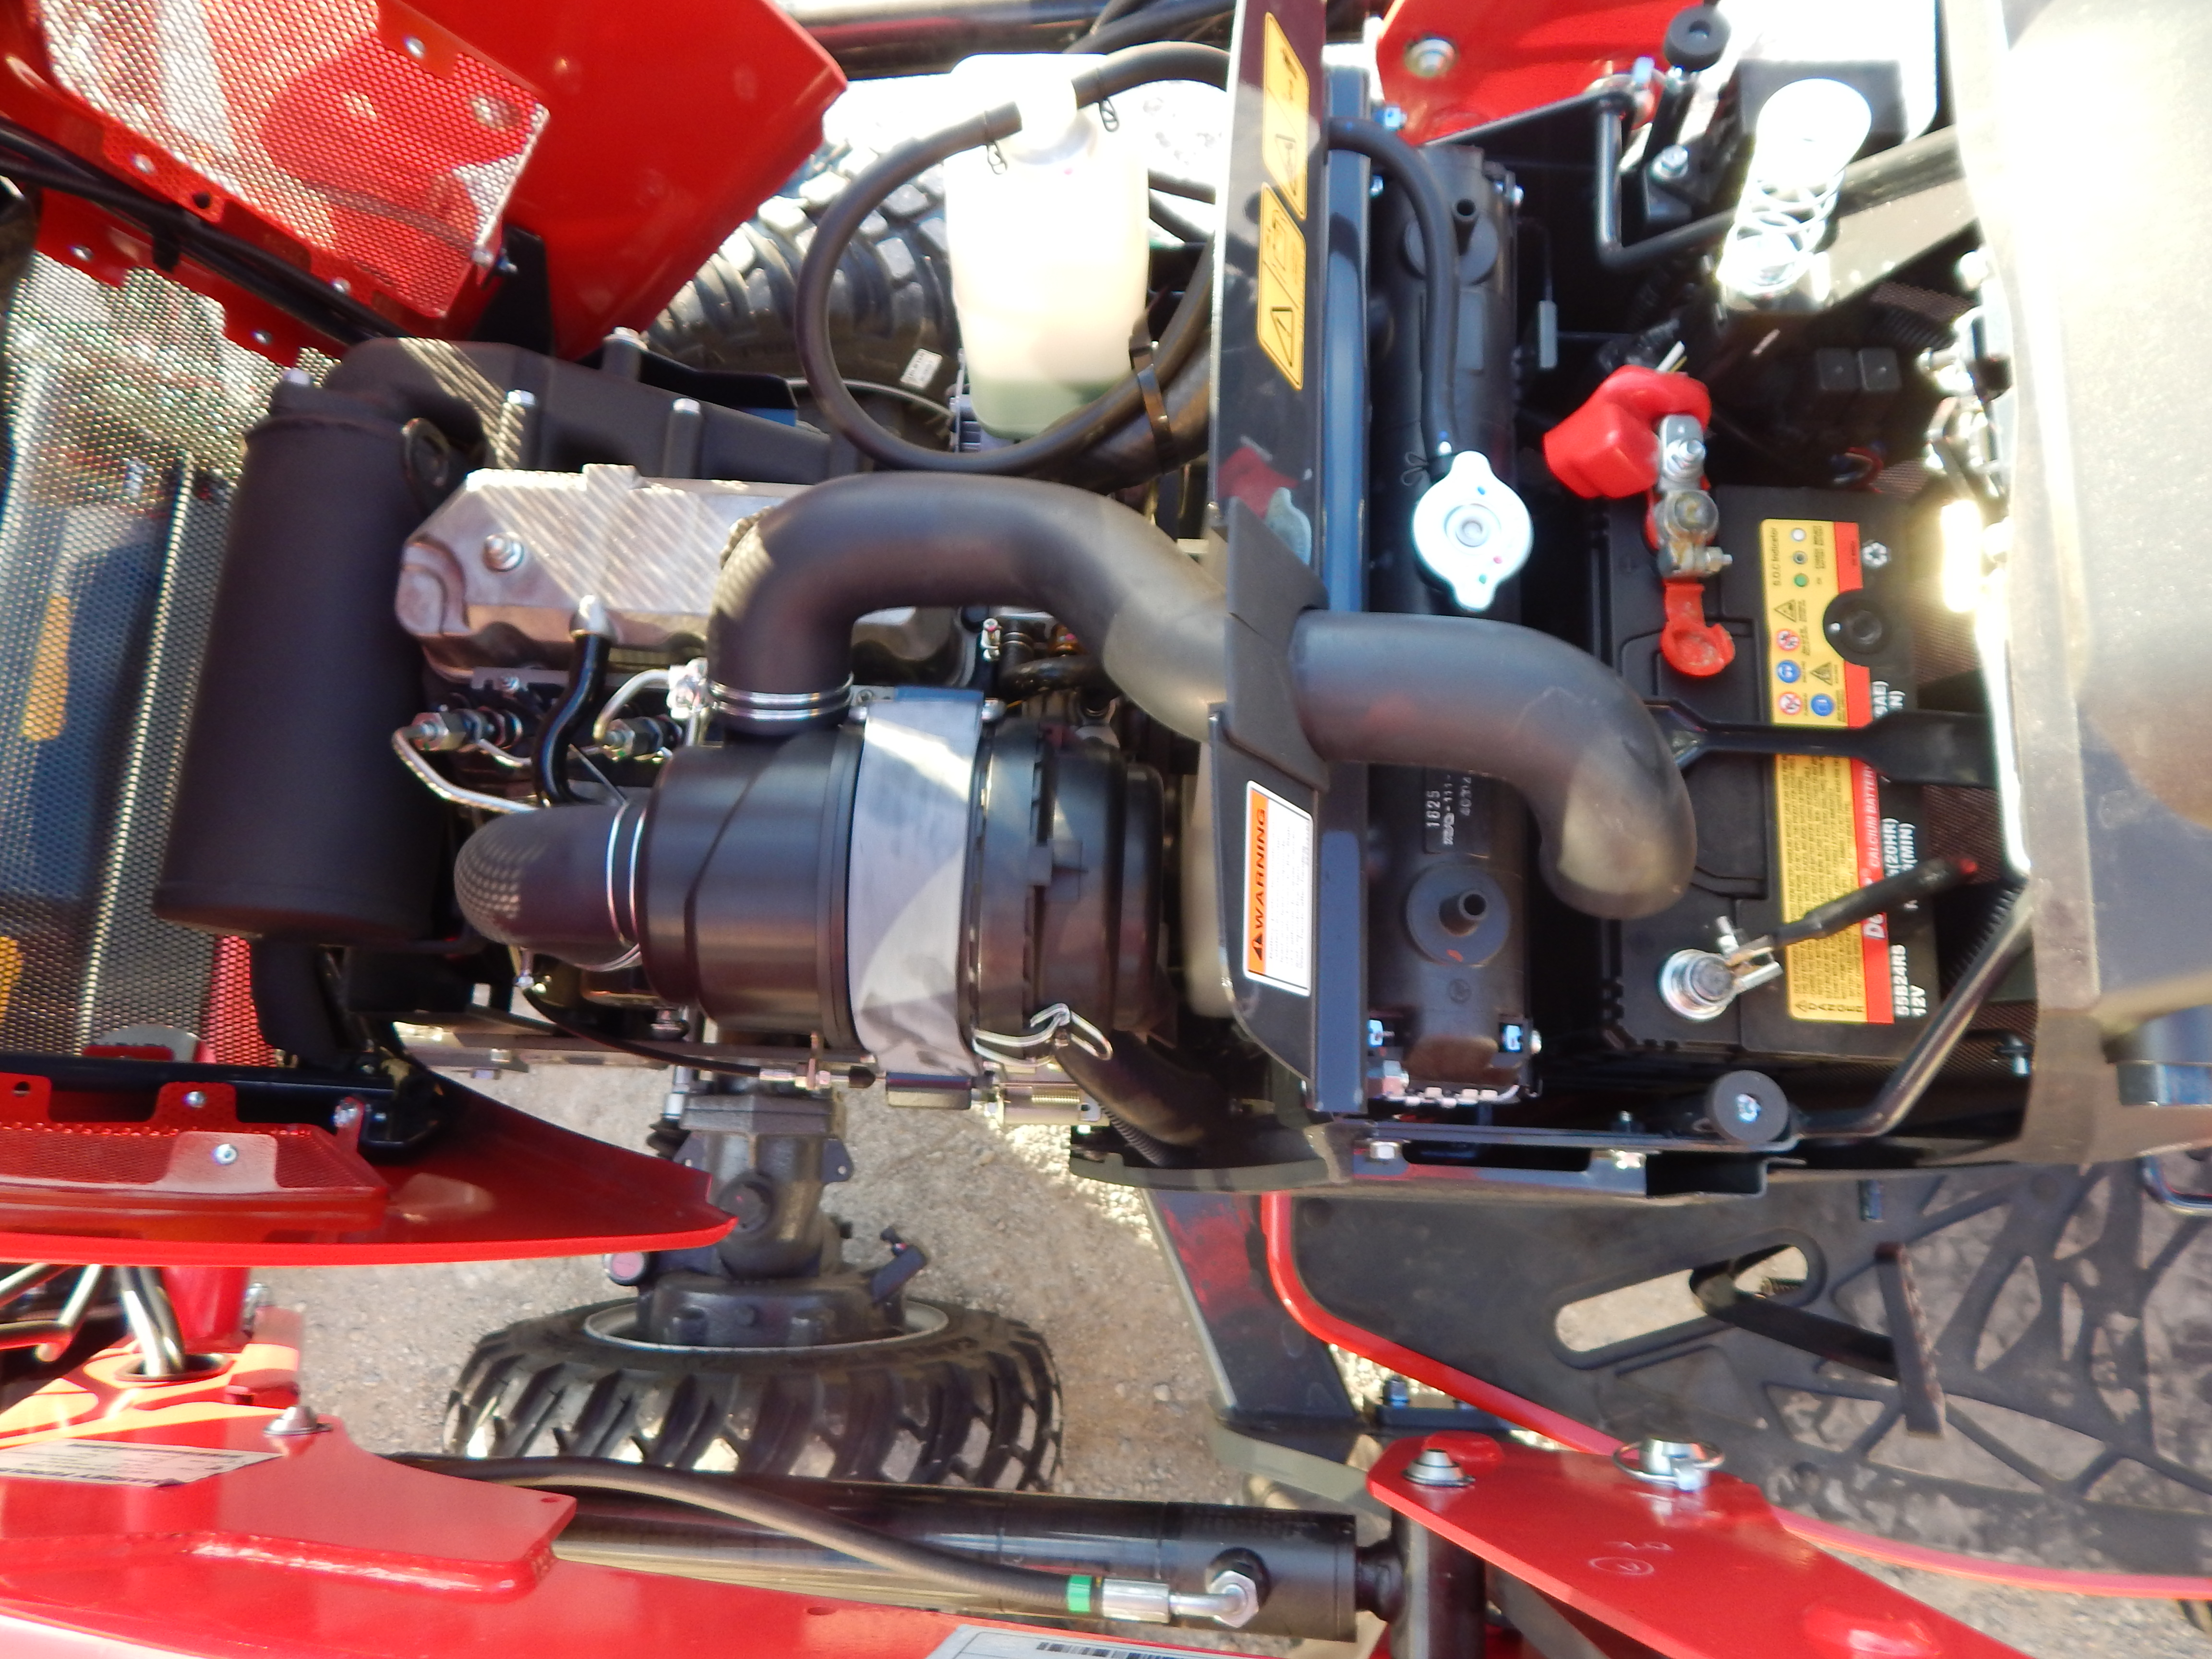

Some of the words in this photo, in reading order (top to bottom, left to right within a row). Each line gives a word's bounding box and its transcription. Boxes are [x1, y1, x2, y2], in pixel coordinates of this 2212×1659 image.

[1770, 527, 1780, 562] Indicator
[1870, 681, 1889, 718] SAE)
[1865, 815, 1880, 867] CALCIUM
[1254, 808, 1266, 929] WARNING
[1808, 1002, 1864, 1013] DANGER
[1910, 985, 1927, 1017] 12V
